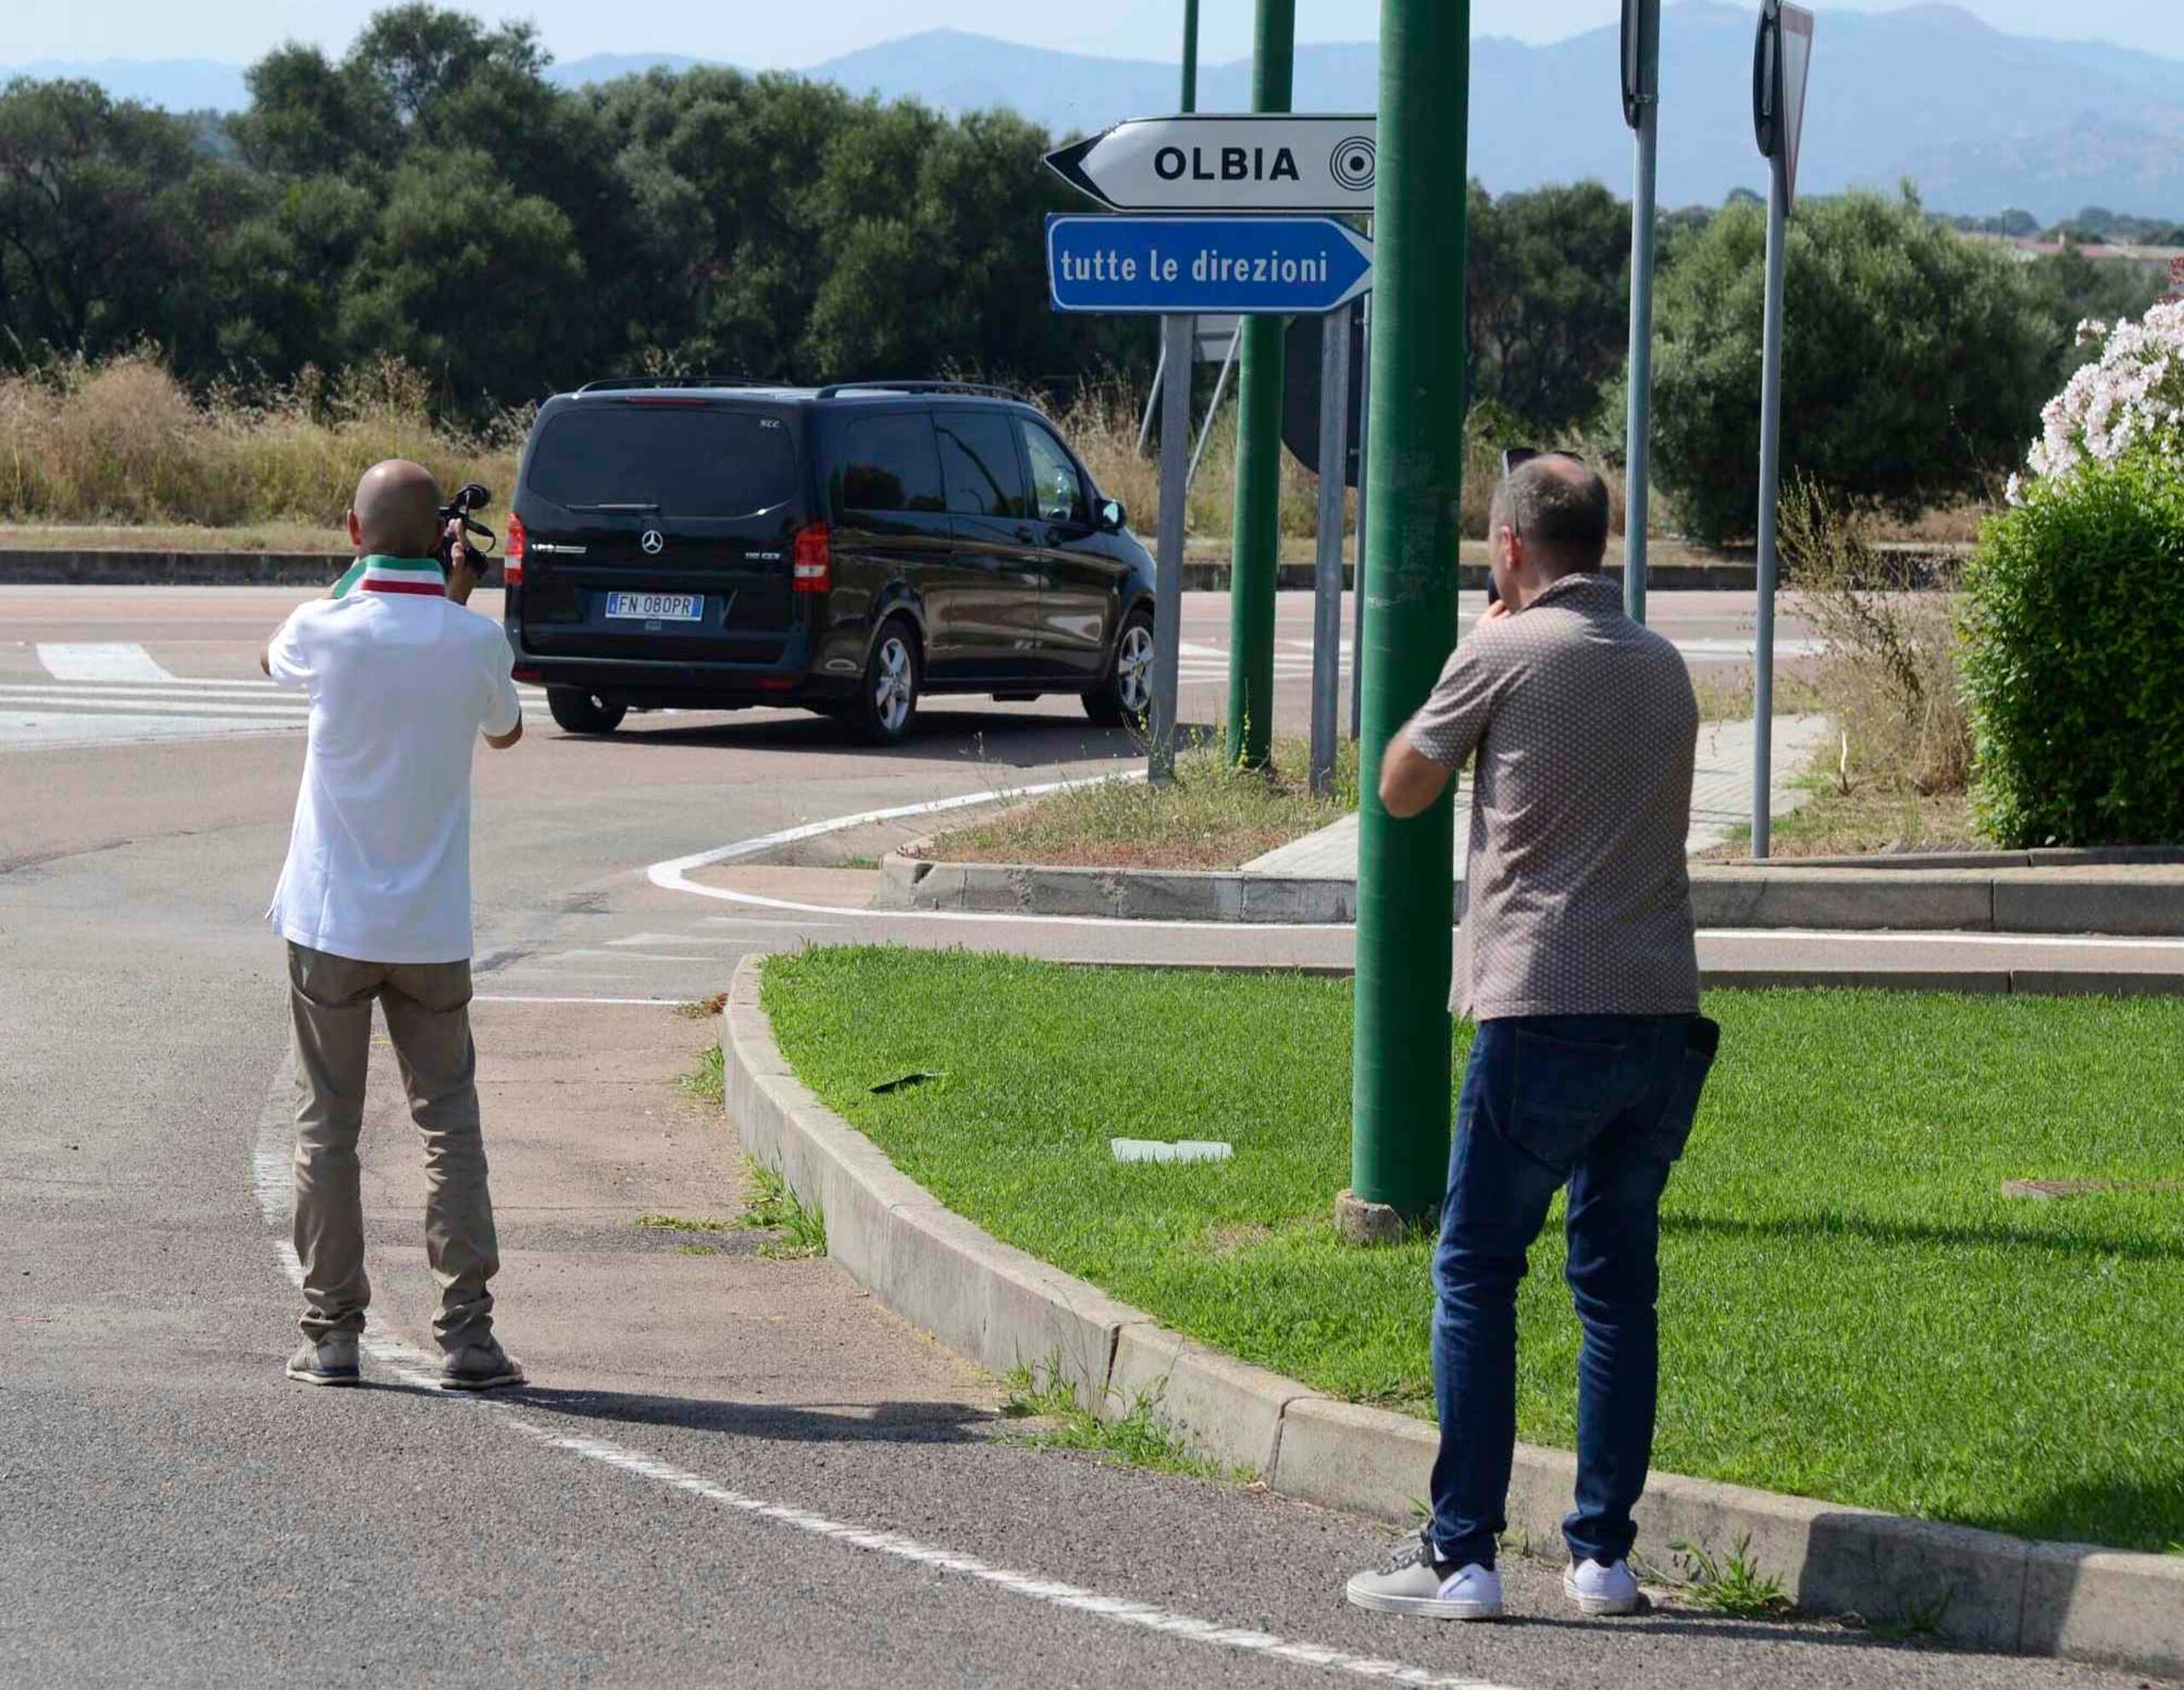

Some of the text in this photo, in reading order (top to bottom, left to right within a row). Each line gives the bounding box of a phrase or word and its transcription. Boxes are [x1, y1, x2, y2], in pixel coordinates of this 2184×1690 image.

[1154, 147, 1299, 181] OLBIA
[1061, 250, 1327, 282] tutte le direzioni
[619, 595, 638, 613] FN
[643, 596, 691, 614] 080PR
